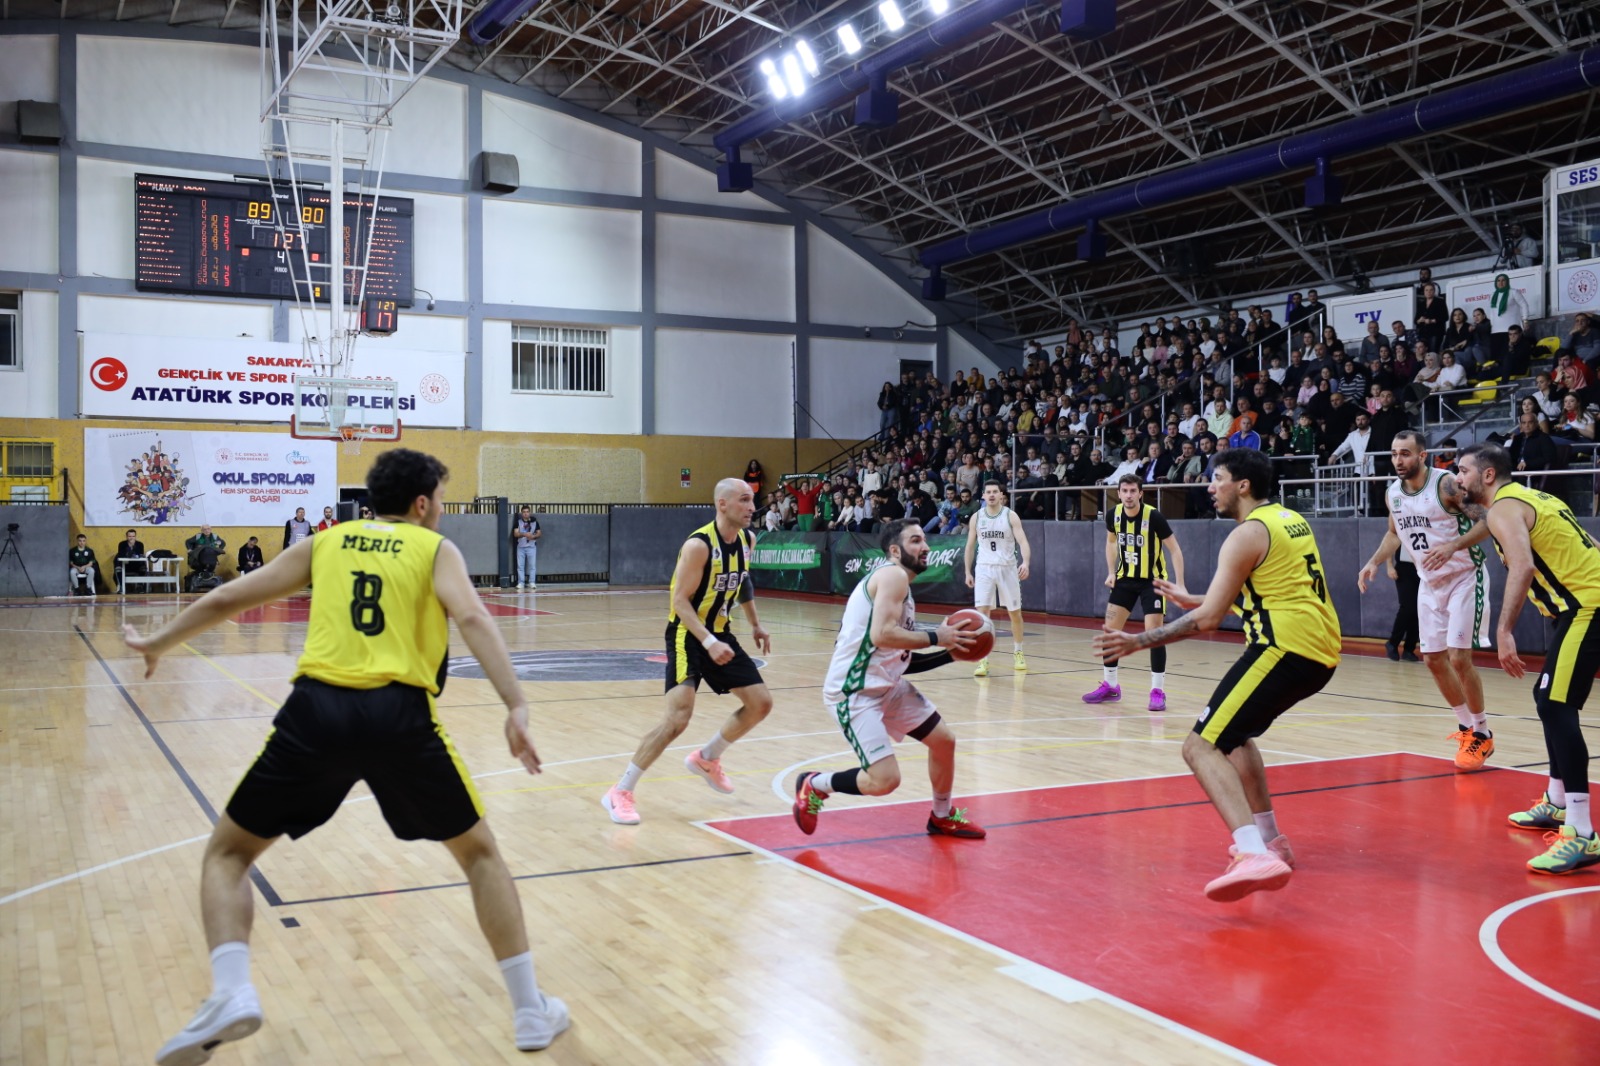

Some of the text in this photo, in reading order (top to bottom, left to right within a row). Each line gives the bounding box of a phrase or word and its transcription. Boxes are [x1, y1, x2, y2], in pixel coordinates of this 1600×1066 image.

[1569, 166, 1598, 186] SES
[248, 202, 271, 219] 89
[302, 206, 324, 224] 80
[277, 250, 285, 264] 4
[377, 312, 393, 329] 17
[1354, 309, 1382, 324] TV
[247, 356, 312, 368] SAKARYA
[157, 367, 223, 382] GENÇLİK
[226, 371, 246, 382] VE
[249, 372, 288, 384] SPOR
[130, 385, 416, 411] ATATÜRK SPOR KOPLEKSİ
[212, 471, 316, 486] OKUL SPORLARI
[249, 495, 281, 504] BAŞARI
[1397, 515, 1433, 531] SAKARYA
[981, 530, 1005, 540] SAKARYA
[1117, 532, 1144, 548] EGO
[1409, 532, 1430, 551] 23
[340, 533, 404, 559] MERİÇ
[990, 541, 997, 552] 8
[844, 557, 863, 573] SON
[1123, 550, 1139, 566] 55
[350, 570, 386, 637] 8
